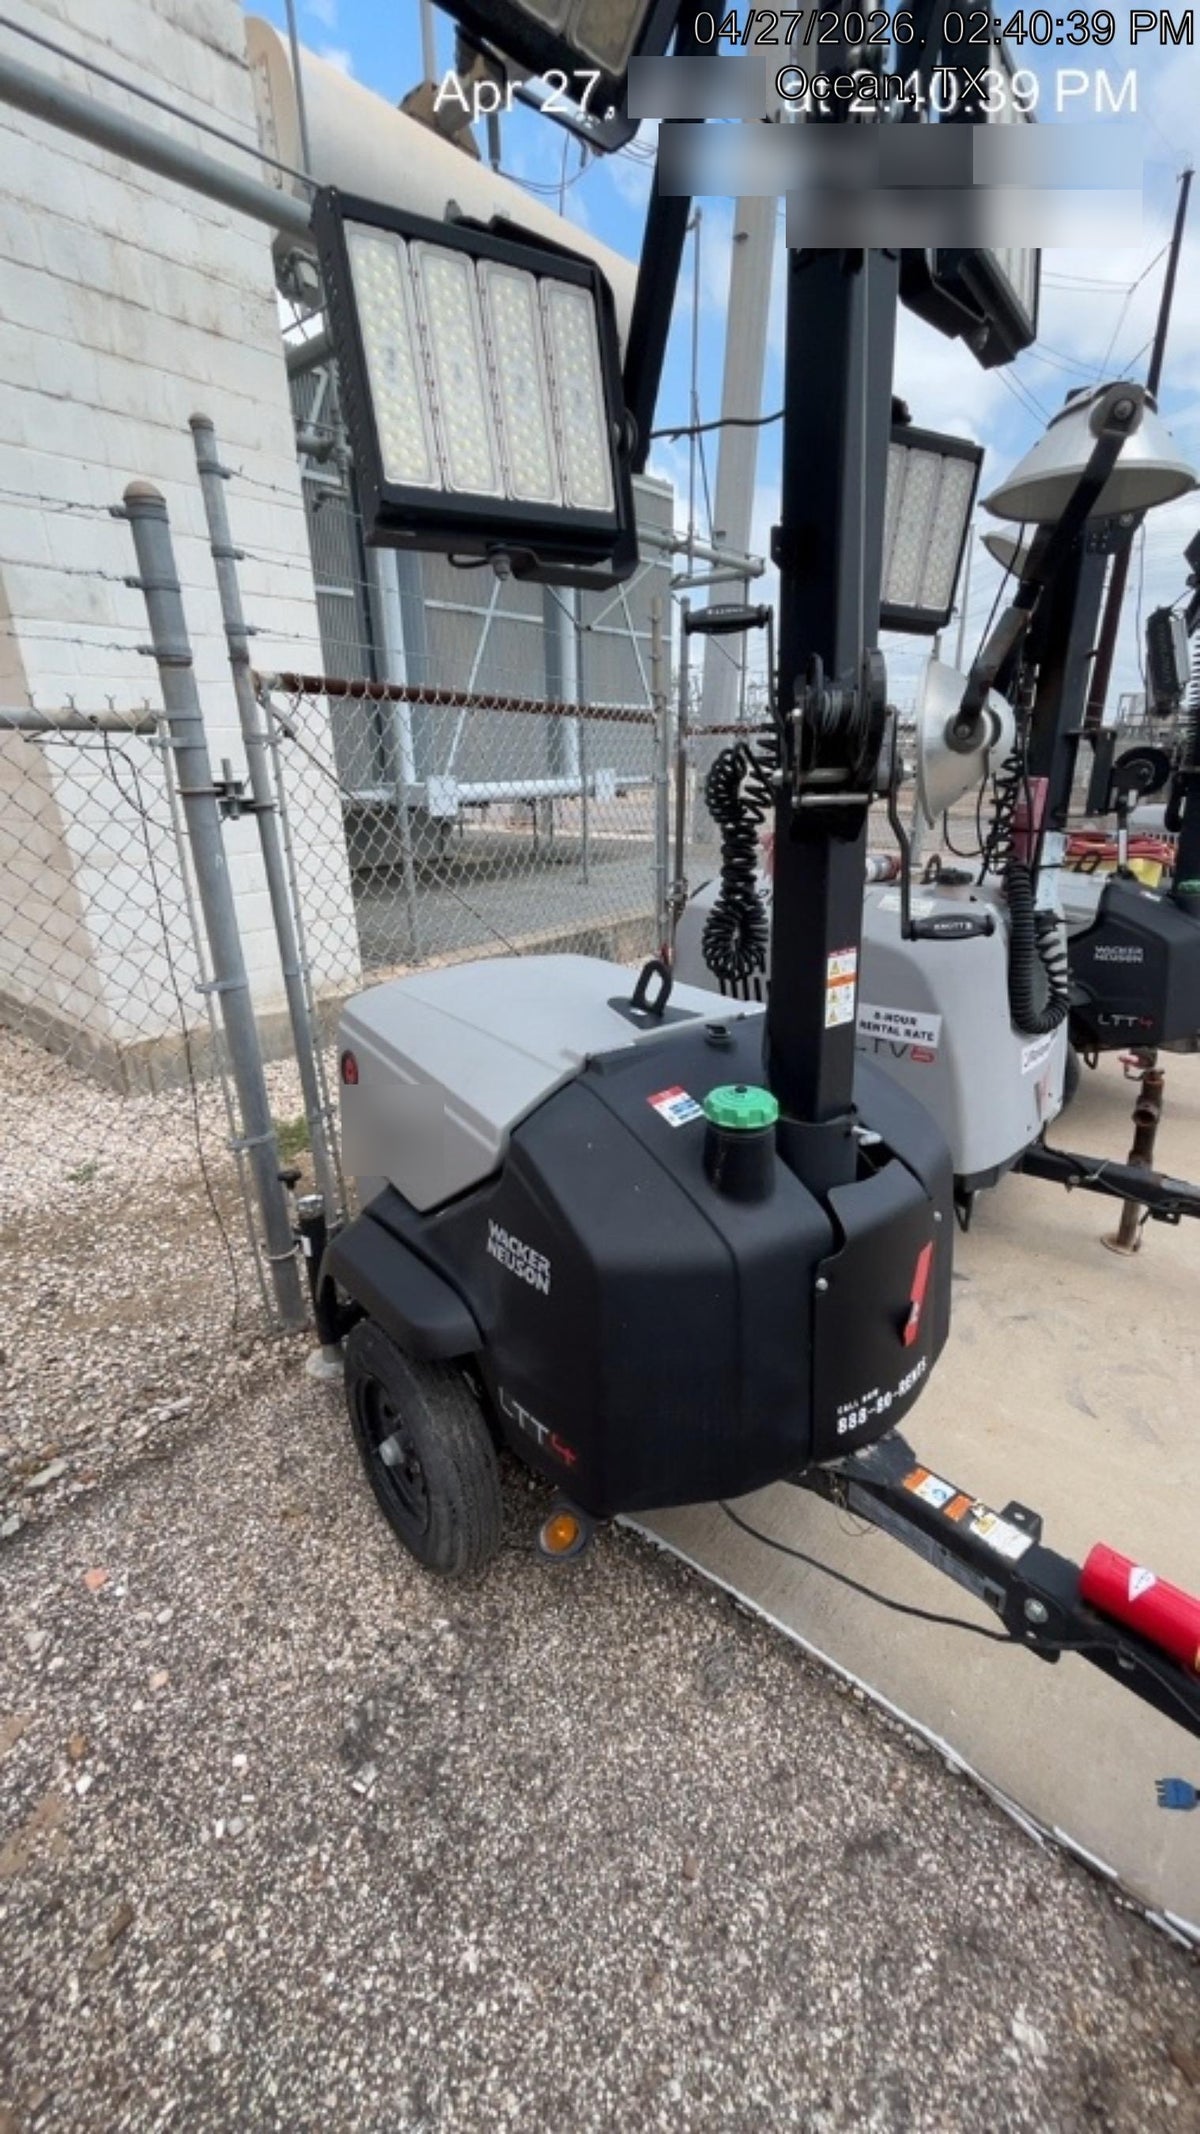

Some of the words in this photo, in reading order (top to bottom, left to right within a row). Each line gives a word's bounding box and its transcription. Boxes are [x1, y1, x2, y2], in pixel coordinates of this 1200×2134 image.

[860, 1020, 901, 1036] RENTAL
[904, 1029, 935, 1041] RATE
[1098, 1013, 1154, 1029] LTT4
[487, 1236, 550, 1296] NEUSON
[488, 1218, 551, 1273] WACKER
[498, 1386, 577, 1467] LTT4
